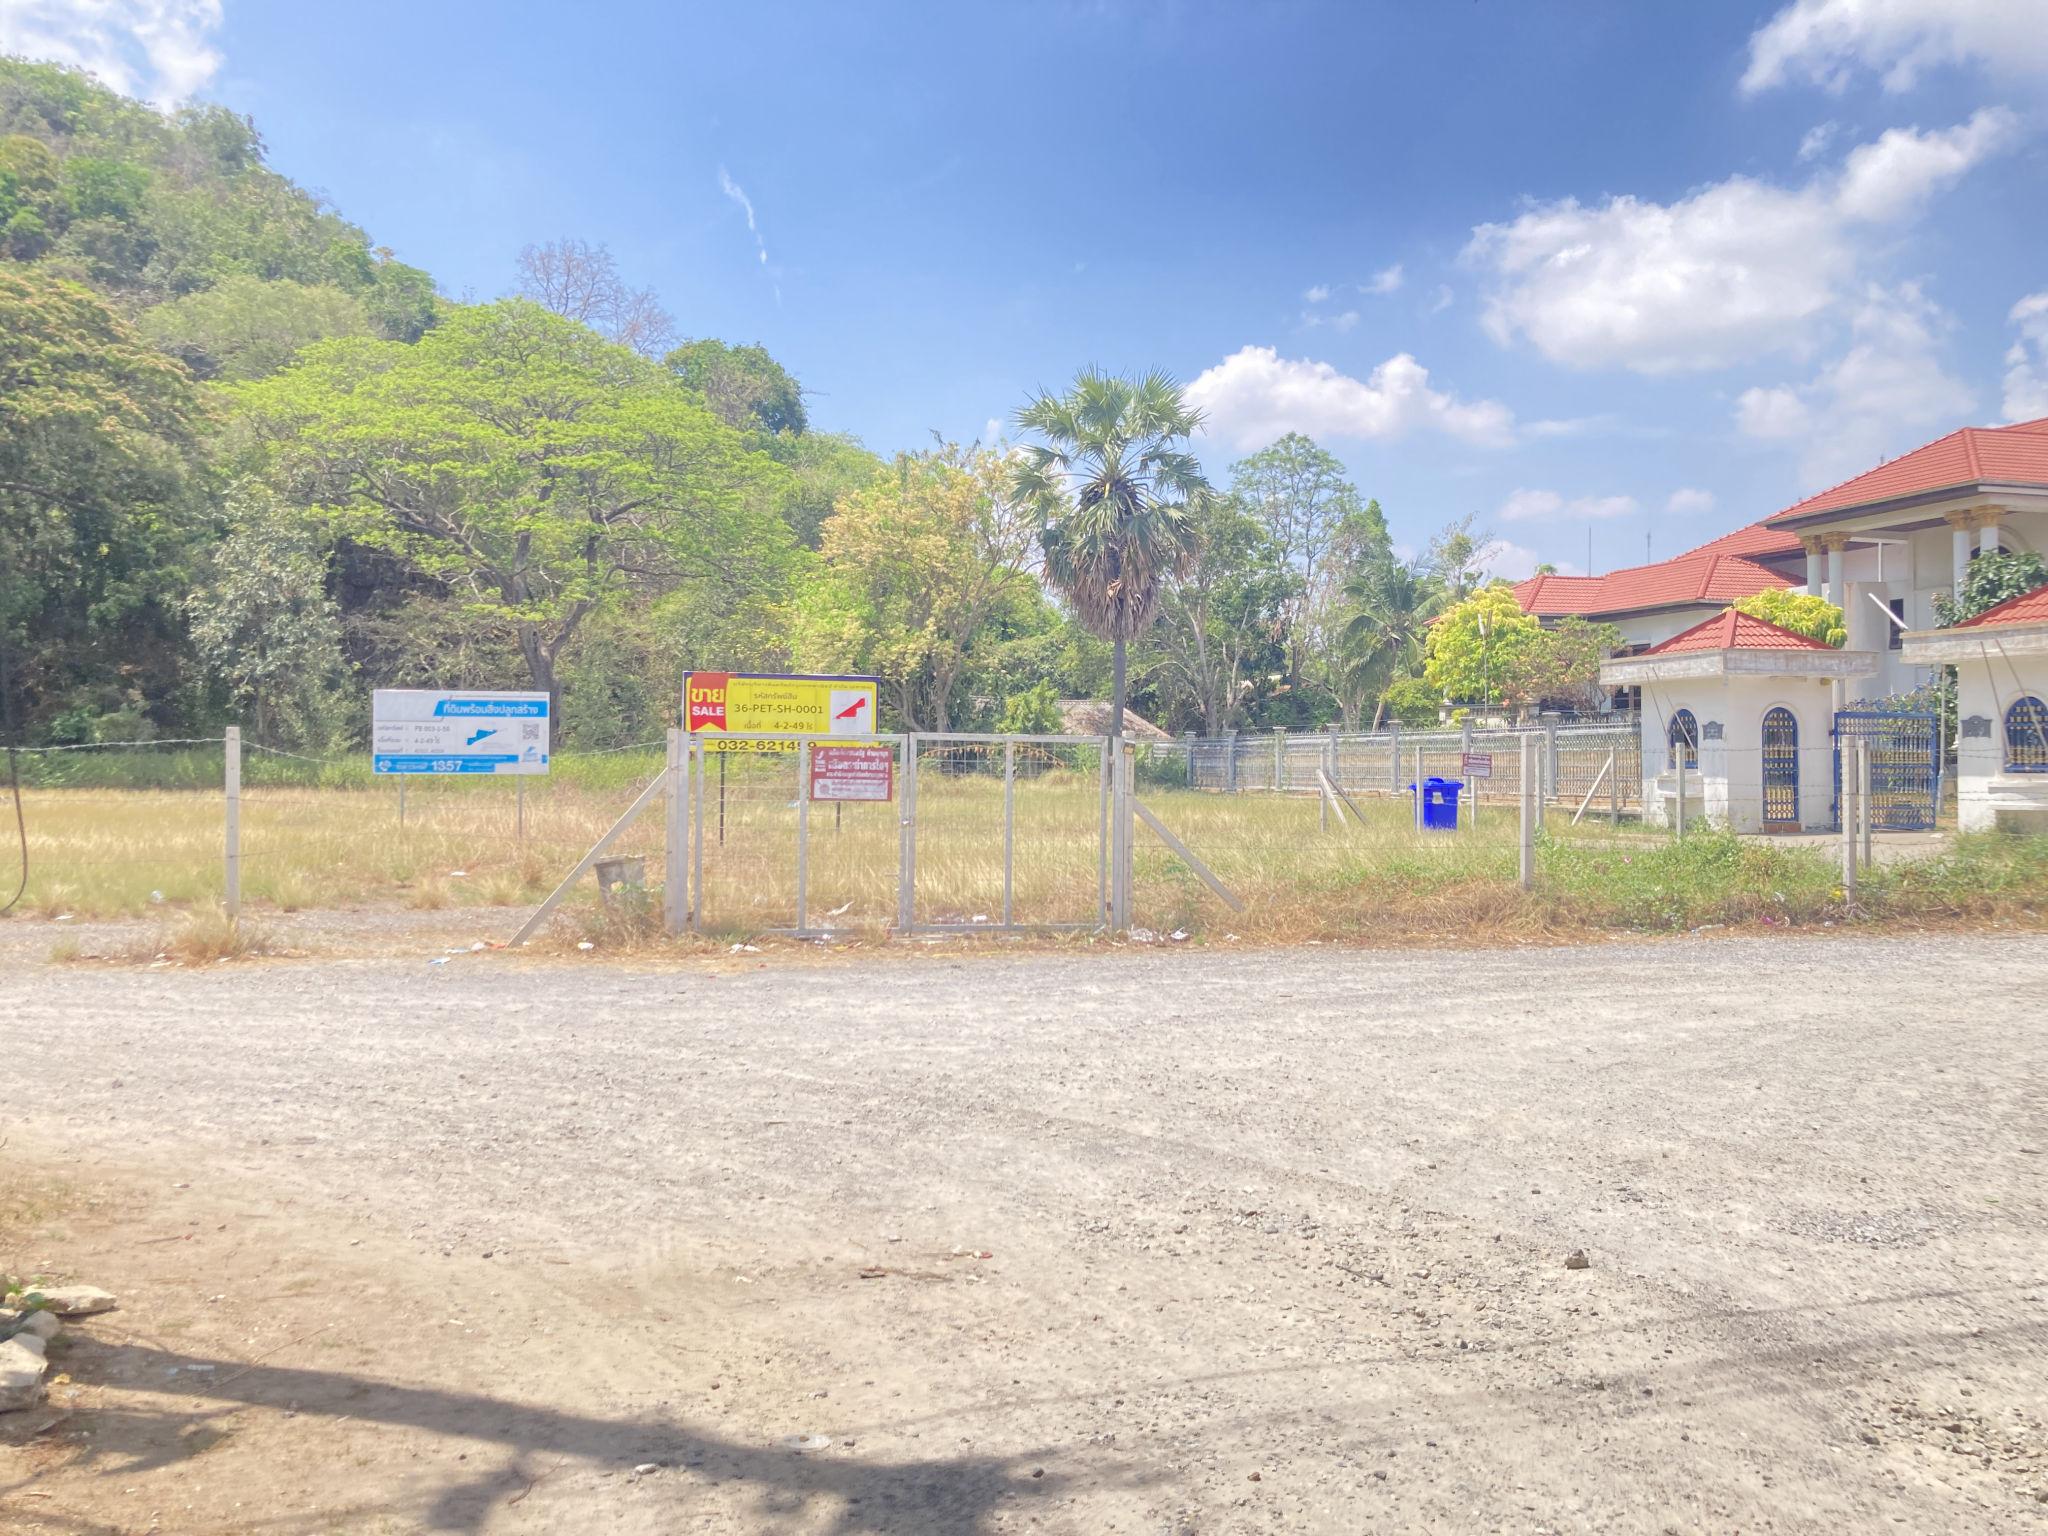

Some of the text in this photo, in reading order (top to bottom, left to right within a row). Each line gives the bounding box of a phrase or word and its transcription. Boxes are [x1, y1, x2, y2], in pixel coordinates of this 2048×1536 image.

[691, 688, 724, 703] ขาย
[443, 701, 539, 717] ที่ดินพร้อมสิ่งปลูกสร้าง
[692, 706, 725, 716] SALE
[734, 703, 824, 714] 36-PET-SH-0001
[774, 721, 805, 730] 4-2-49
[431, 760, 463, 772] 1357
